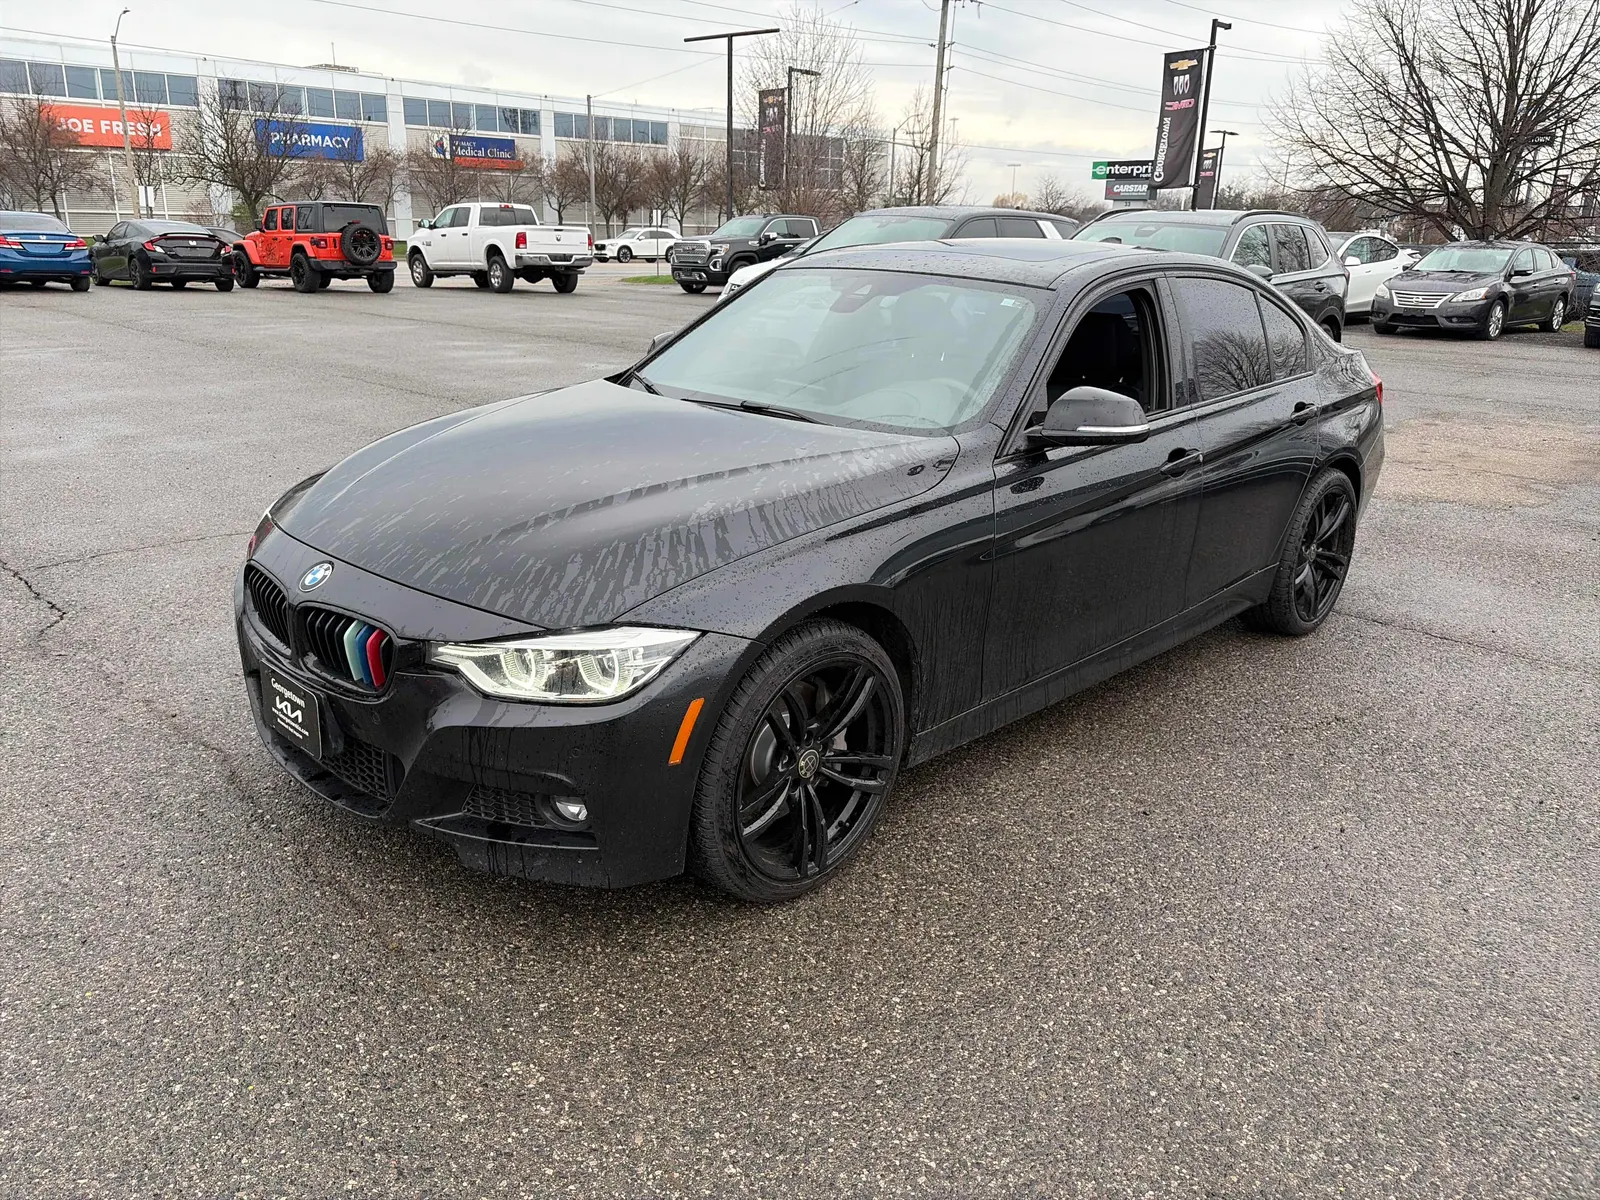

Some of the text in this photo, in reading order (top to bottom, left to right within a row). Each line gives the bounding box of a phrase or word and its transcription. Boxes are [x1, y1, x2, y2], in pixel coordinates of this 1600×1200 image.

[57, 118, 162, 137] JOE FRESH
[270, 132, 350, 148] PHARMACY
[487, 148, 512, 158] Clinic
[1092, 162, 1152, 177] enterpri
[1113, 184, 1148, 192] CARSTAR
[271, 678, 305, 708] Georgetown
